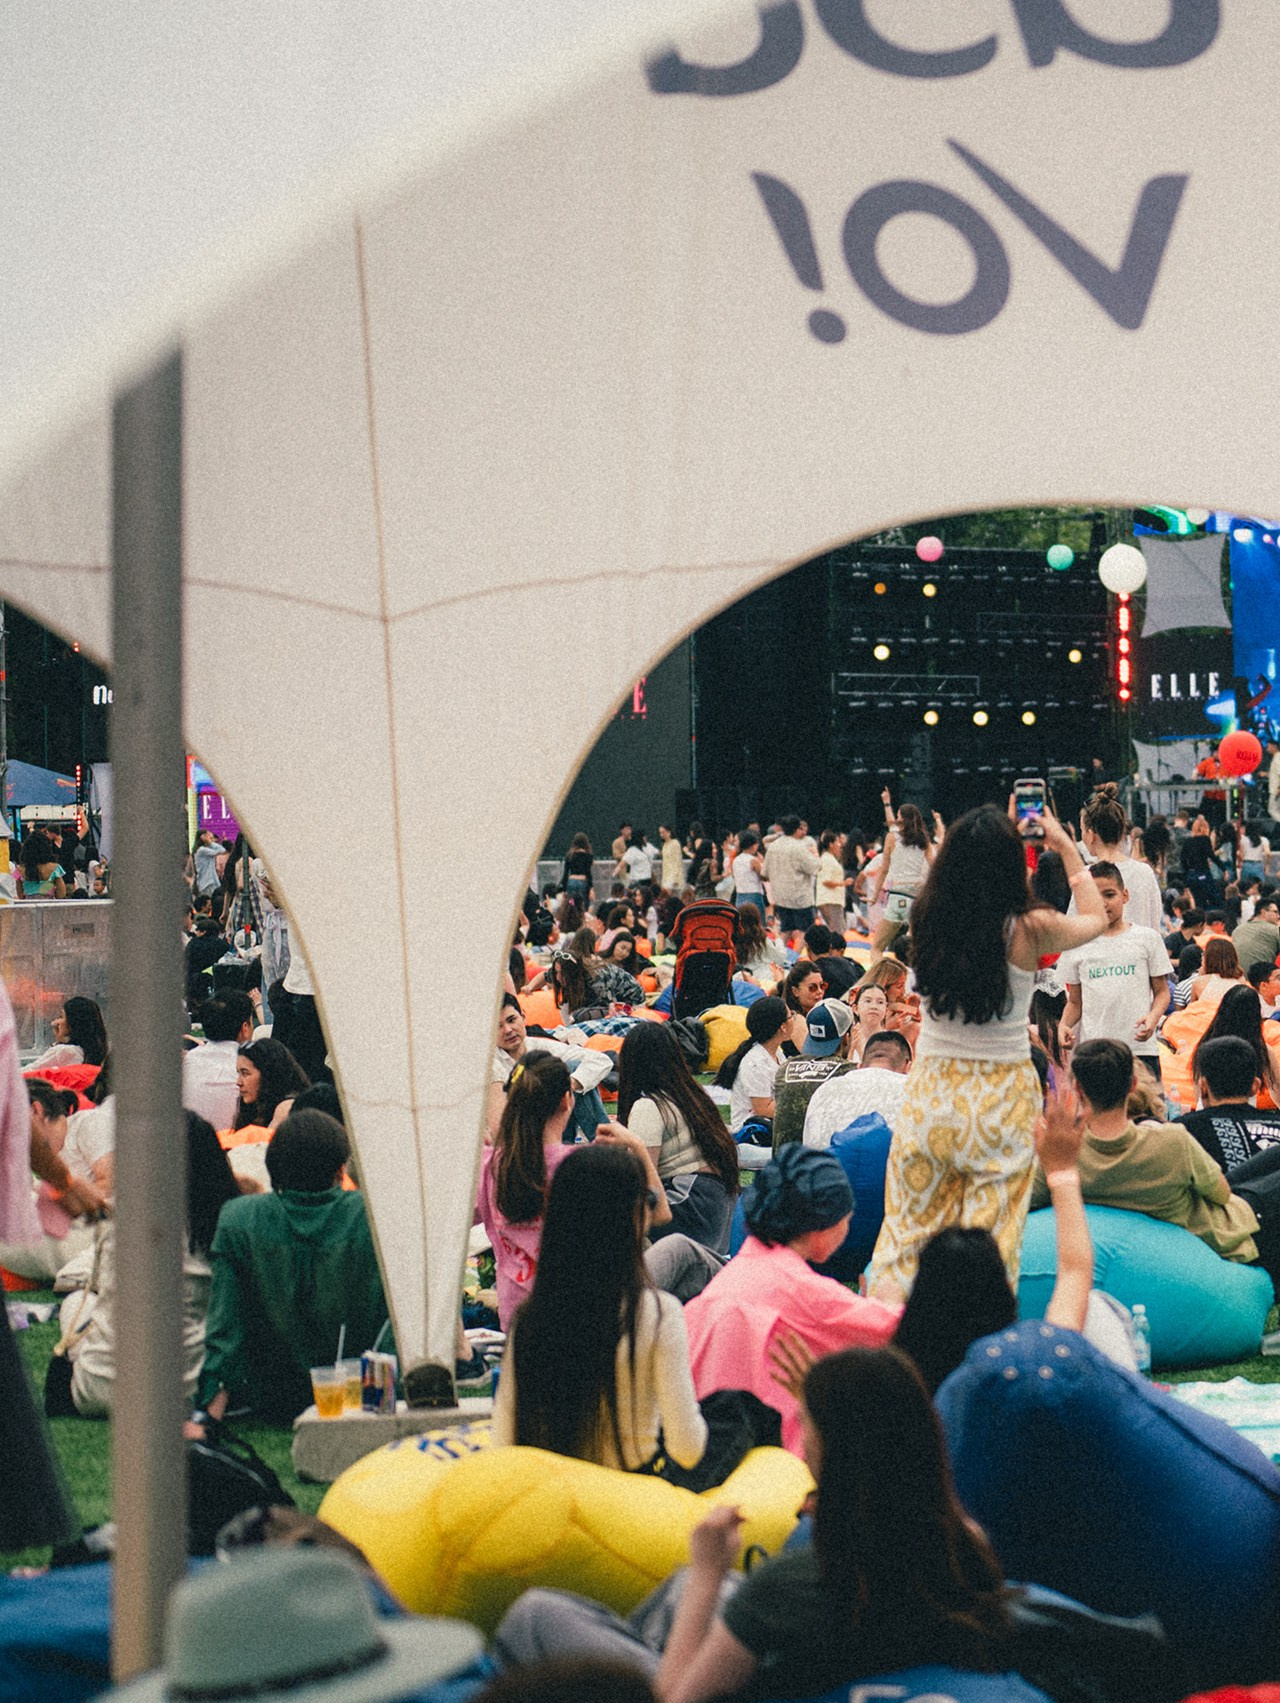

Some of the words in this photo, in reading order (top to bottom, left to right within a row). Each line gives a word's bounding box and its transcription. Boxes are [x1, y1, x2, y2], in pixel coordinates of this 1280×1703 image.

[1151, 672, 1220, 698] ELLE
[203, 795, 230, 819] EL
[1089, 964, 1136, 979] NEXTOUT
